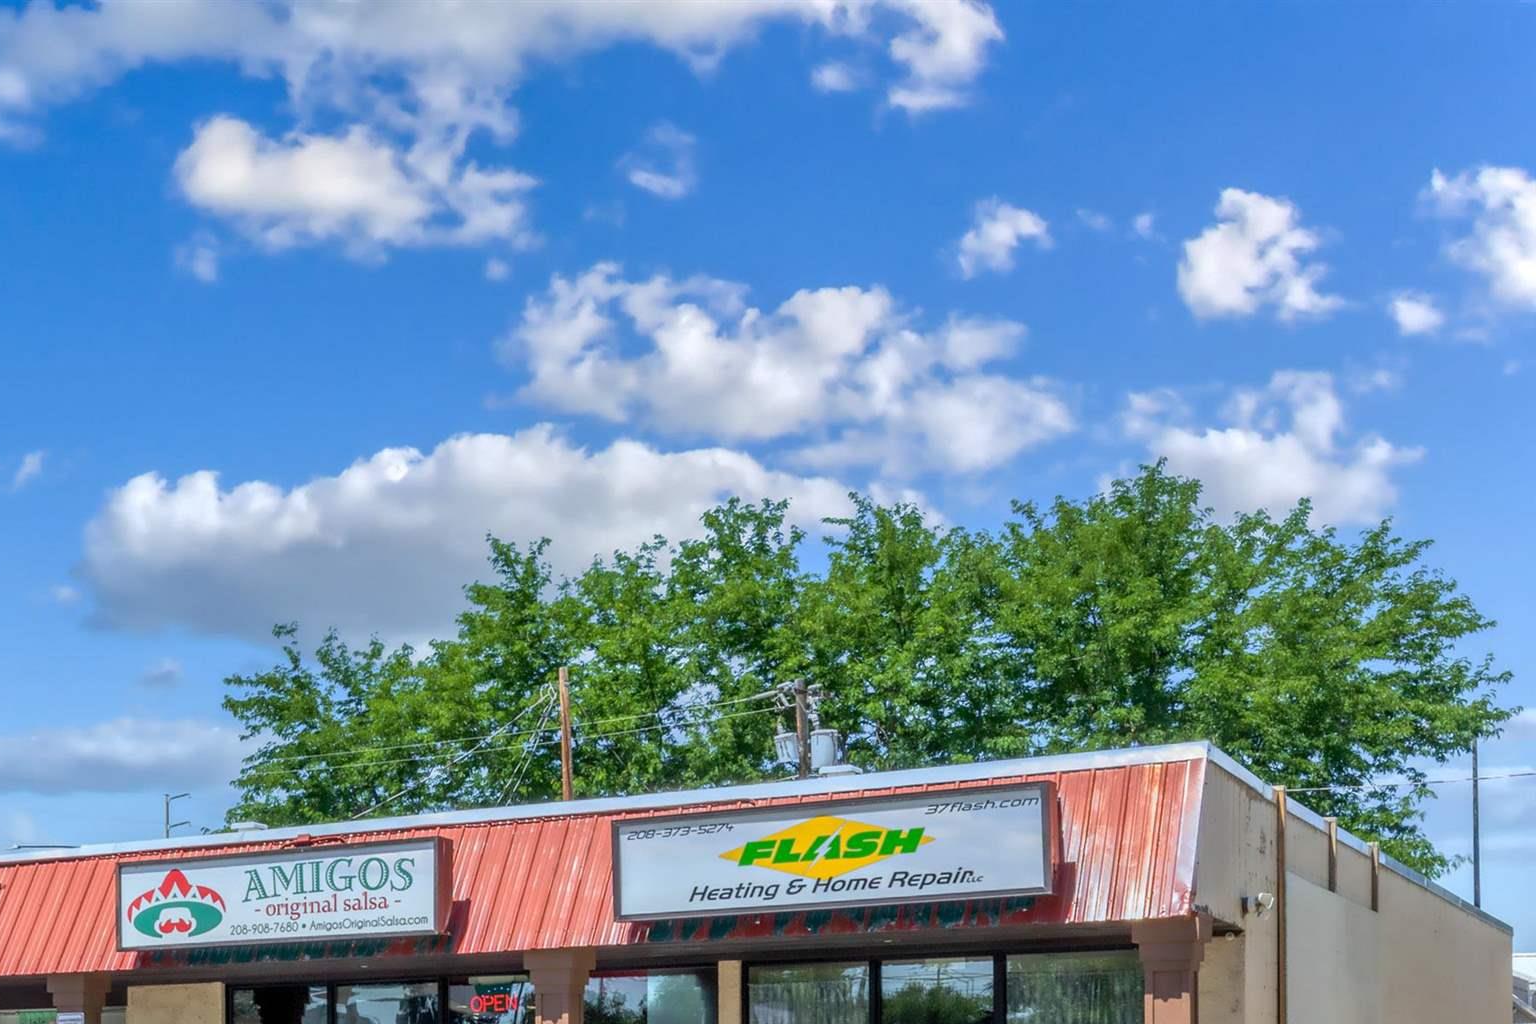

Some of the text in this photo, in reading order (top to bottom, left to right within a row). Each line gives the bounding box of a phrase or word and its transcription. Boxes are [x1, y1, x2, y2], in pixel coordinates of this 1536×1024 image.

[925, 797, 1040, 815] 37flash.com
[627, 822, 734, 840] 208-373-5274
[737, 827, 925, 867] FLASH
[242, 857, 415, 903] AMIGOS
[689, 882, 780, 902] Heating
[786, 878, 806, 895] &
[812, 876, 882, 894] Home
[888, 867, 974, 890] Repair
[266, 893, 337, 920] original
[343, 891, 390, 912] salsa
[230, 914, 429, 936] 208-908-7680 AmigosOriginalSalsa.com
[470, 993, 519, 1013] OPEN
